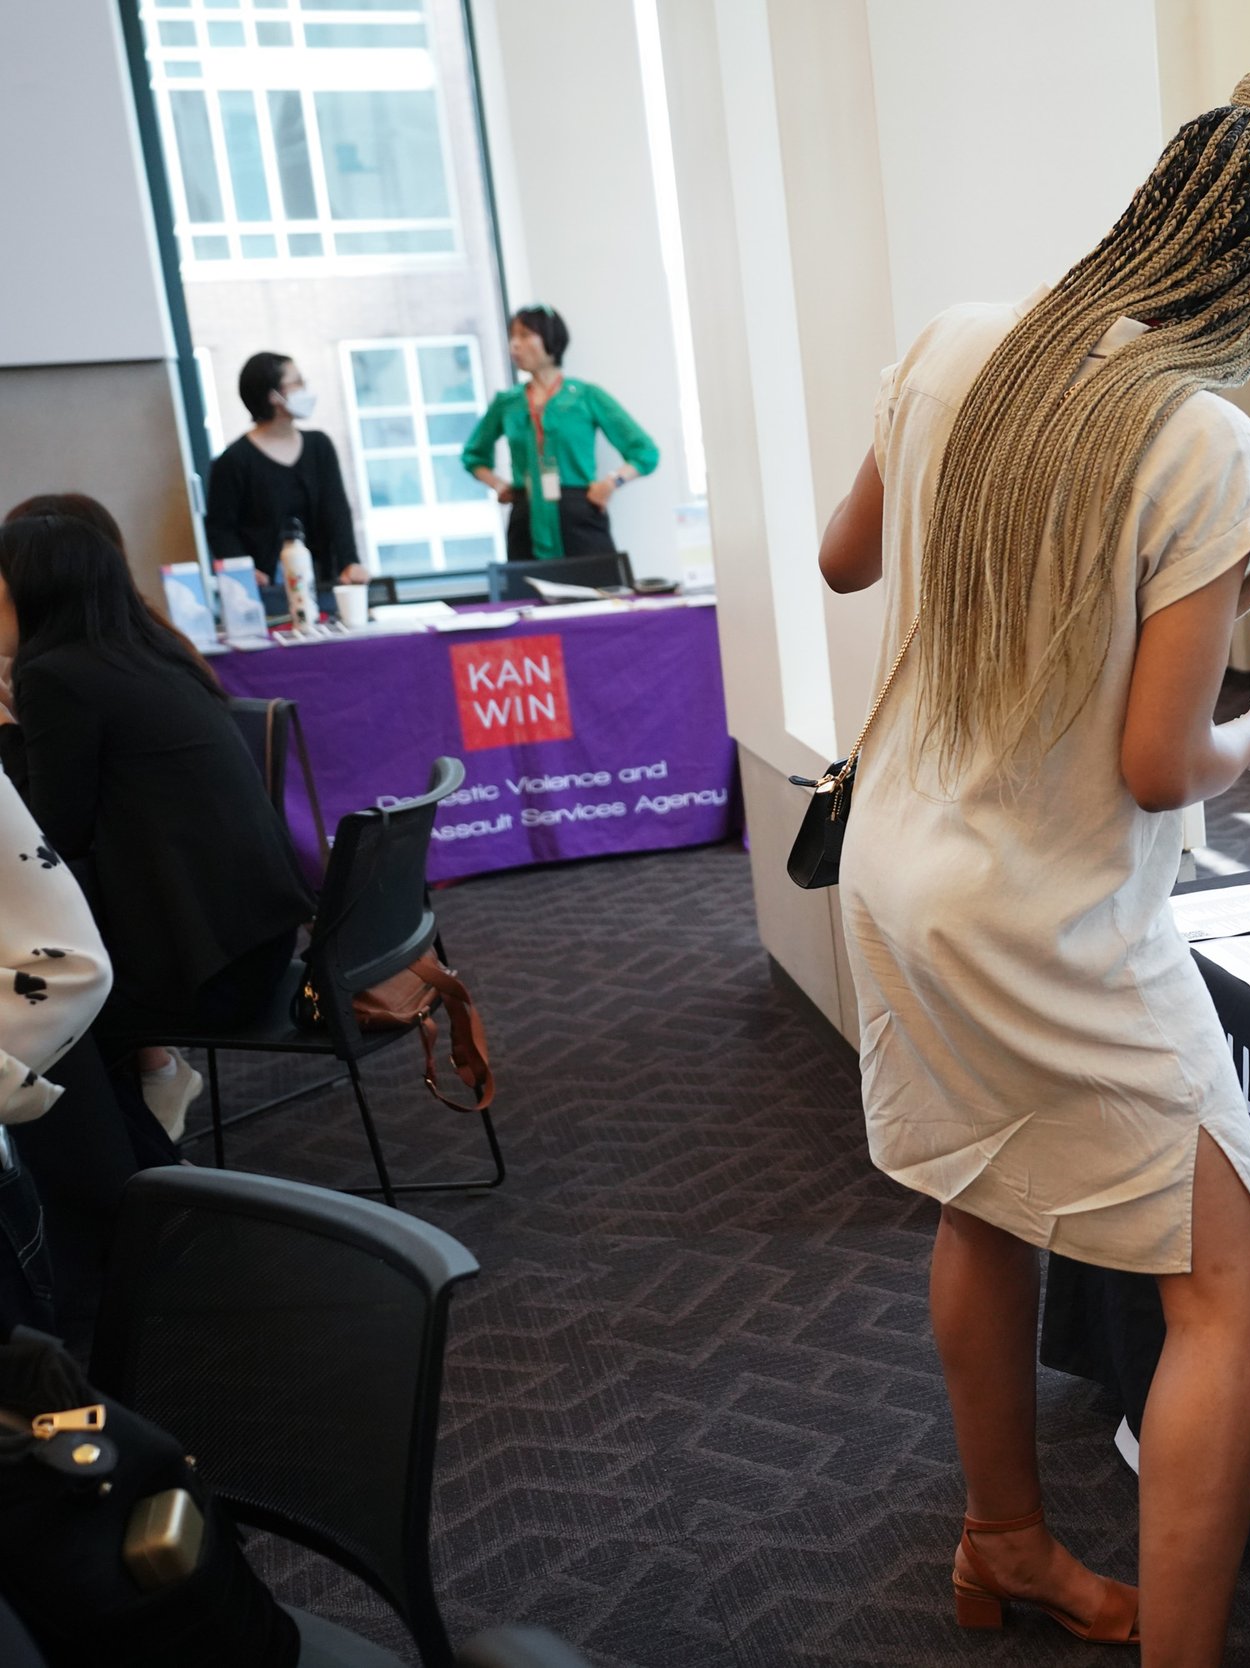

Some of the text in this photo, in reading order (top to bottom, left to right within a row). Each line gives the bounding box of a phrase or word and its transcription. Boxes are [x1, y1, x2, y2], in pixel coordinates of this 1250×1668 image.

[468, 655, 551, 693] KAN
[473, 692, 556, 729] WIN
[377, 761, 668, 810] Destic Violence and
[521, 800, 626, 828] Services
[634, 786, 729, 814] Agency
